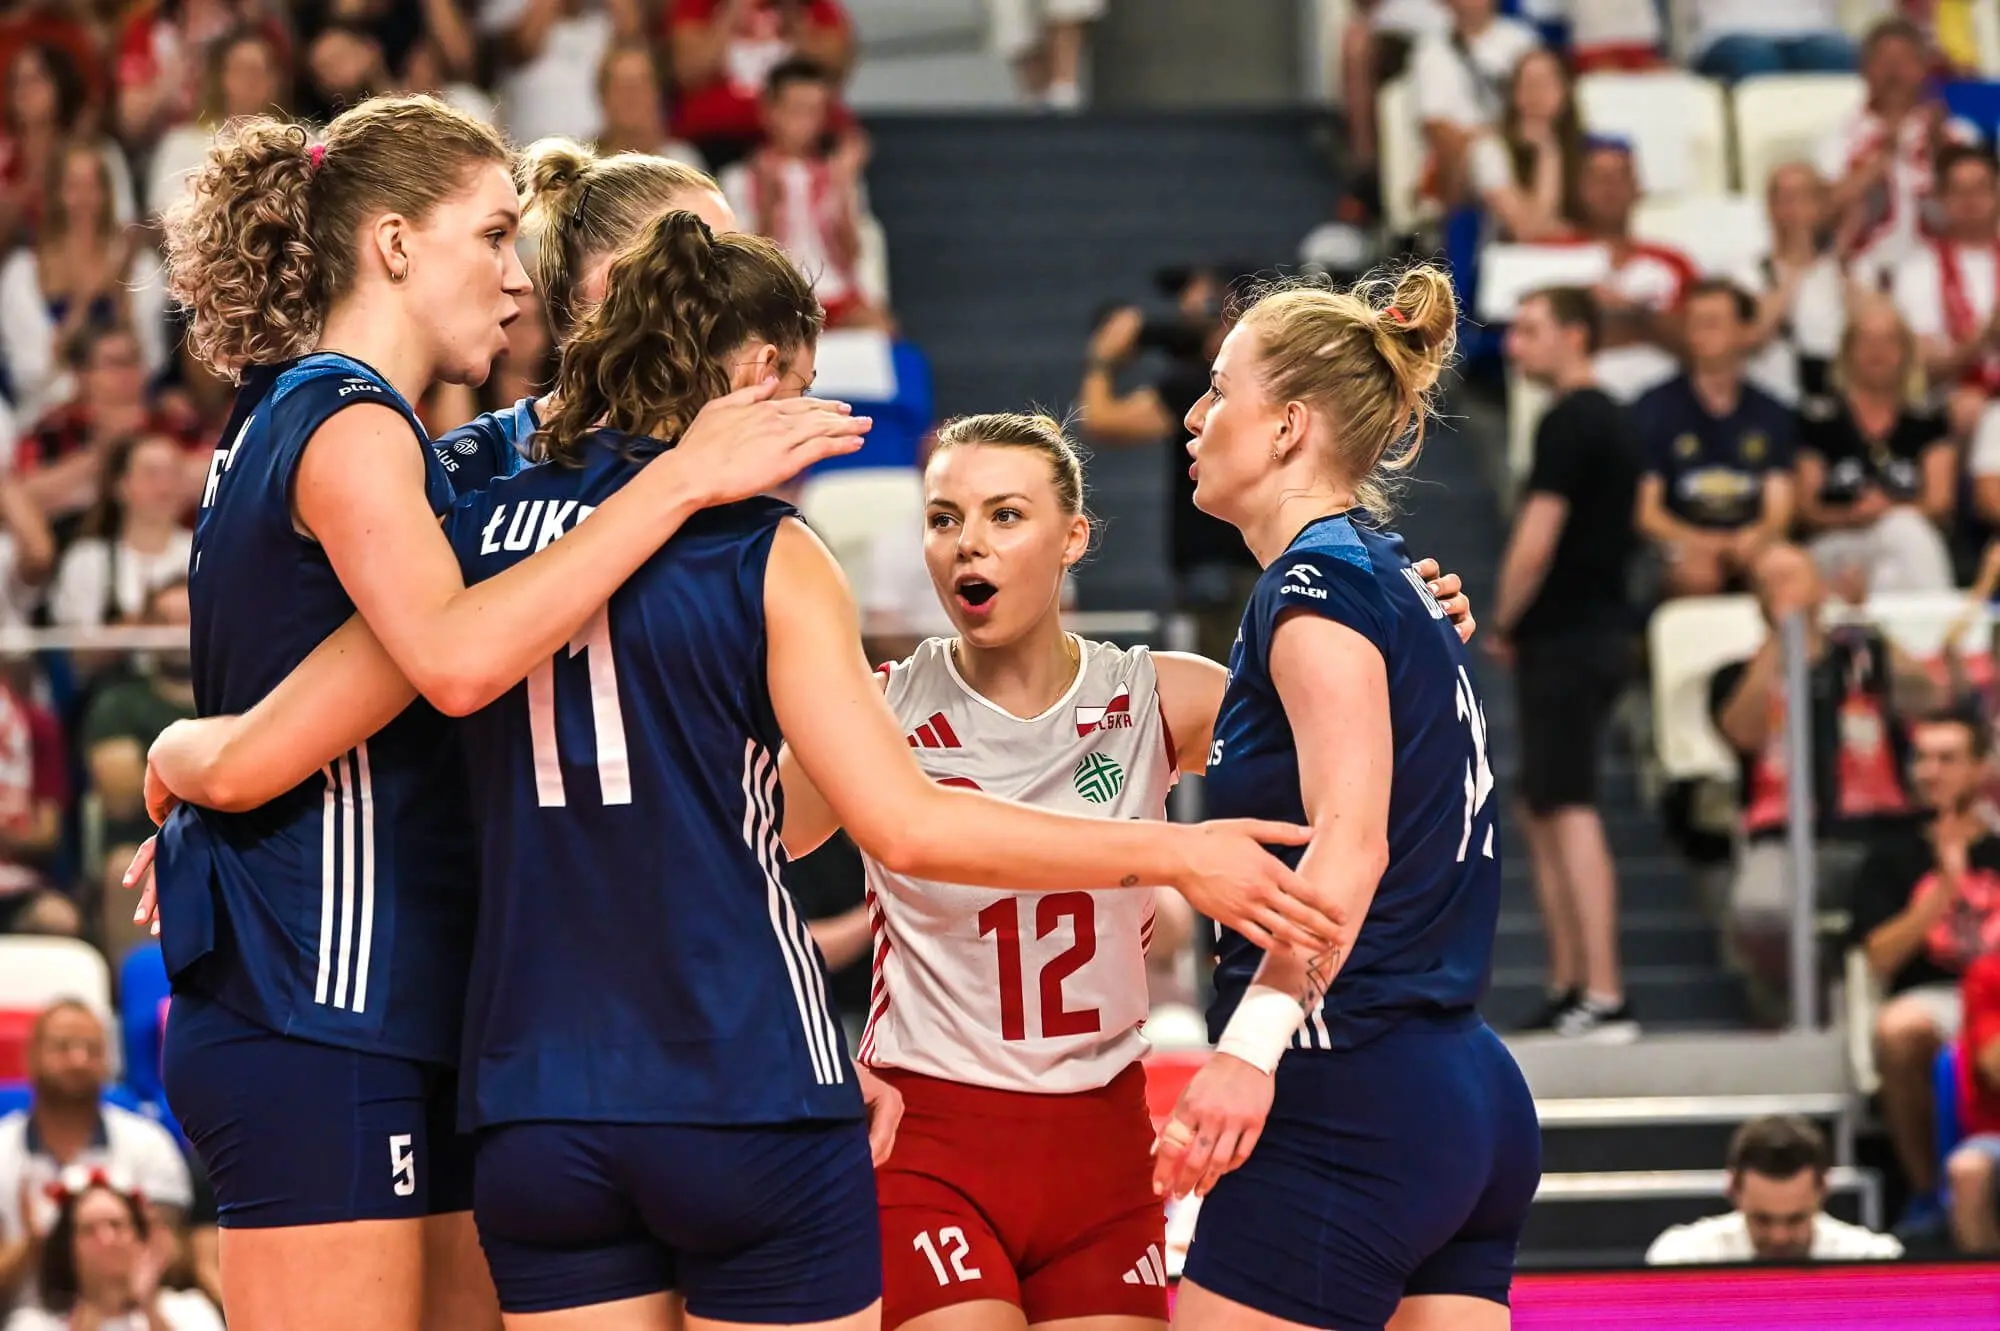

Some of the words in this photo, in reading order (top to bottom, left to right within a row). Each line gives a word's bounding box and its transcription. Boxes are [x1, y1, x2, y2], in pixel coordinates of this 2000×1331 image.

[1280, 585, 1328, 600] ORLEN
[978, 891, 1101, 1041] 12
[389, 1133, 415, 1196] 5
[912, 1226, 982, 1286] 12
